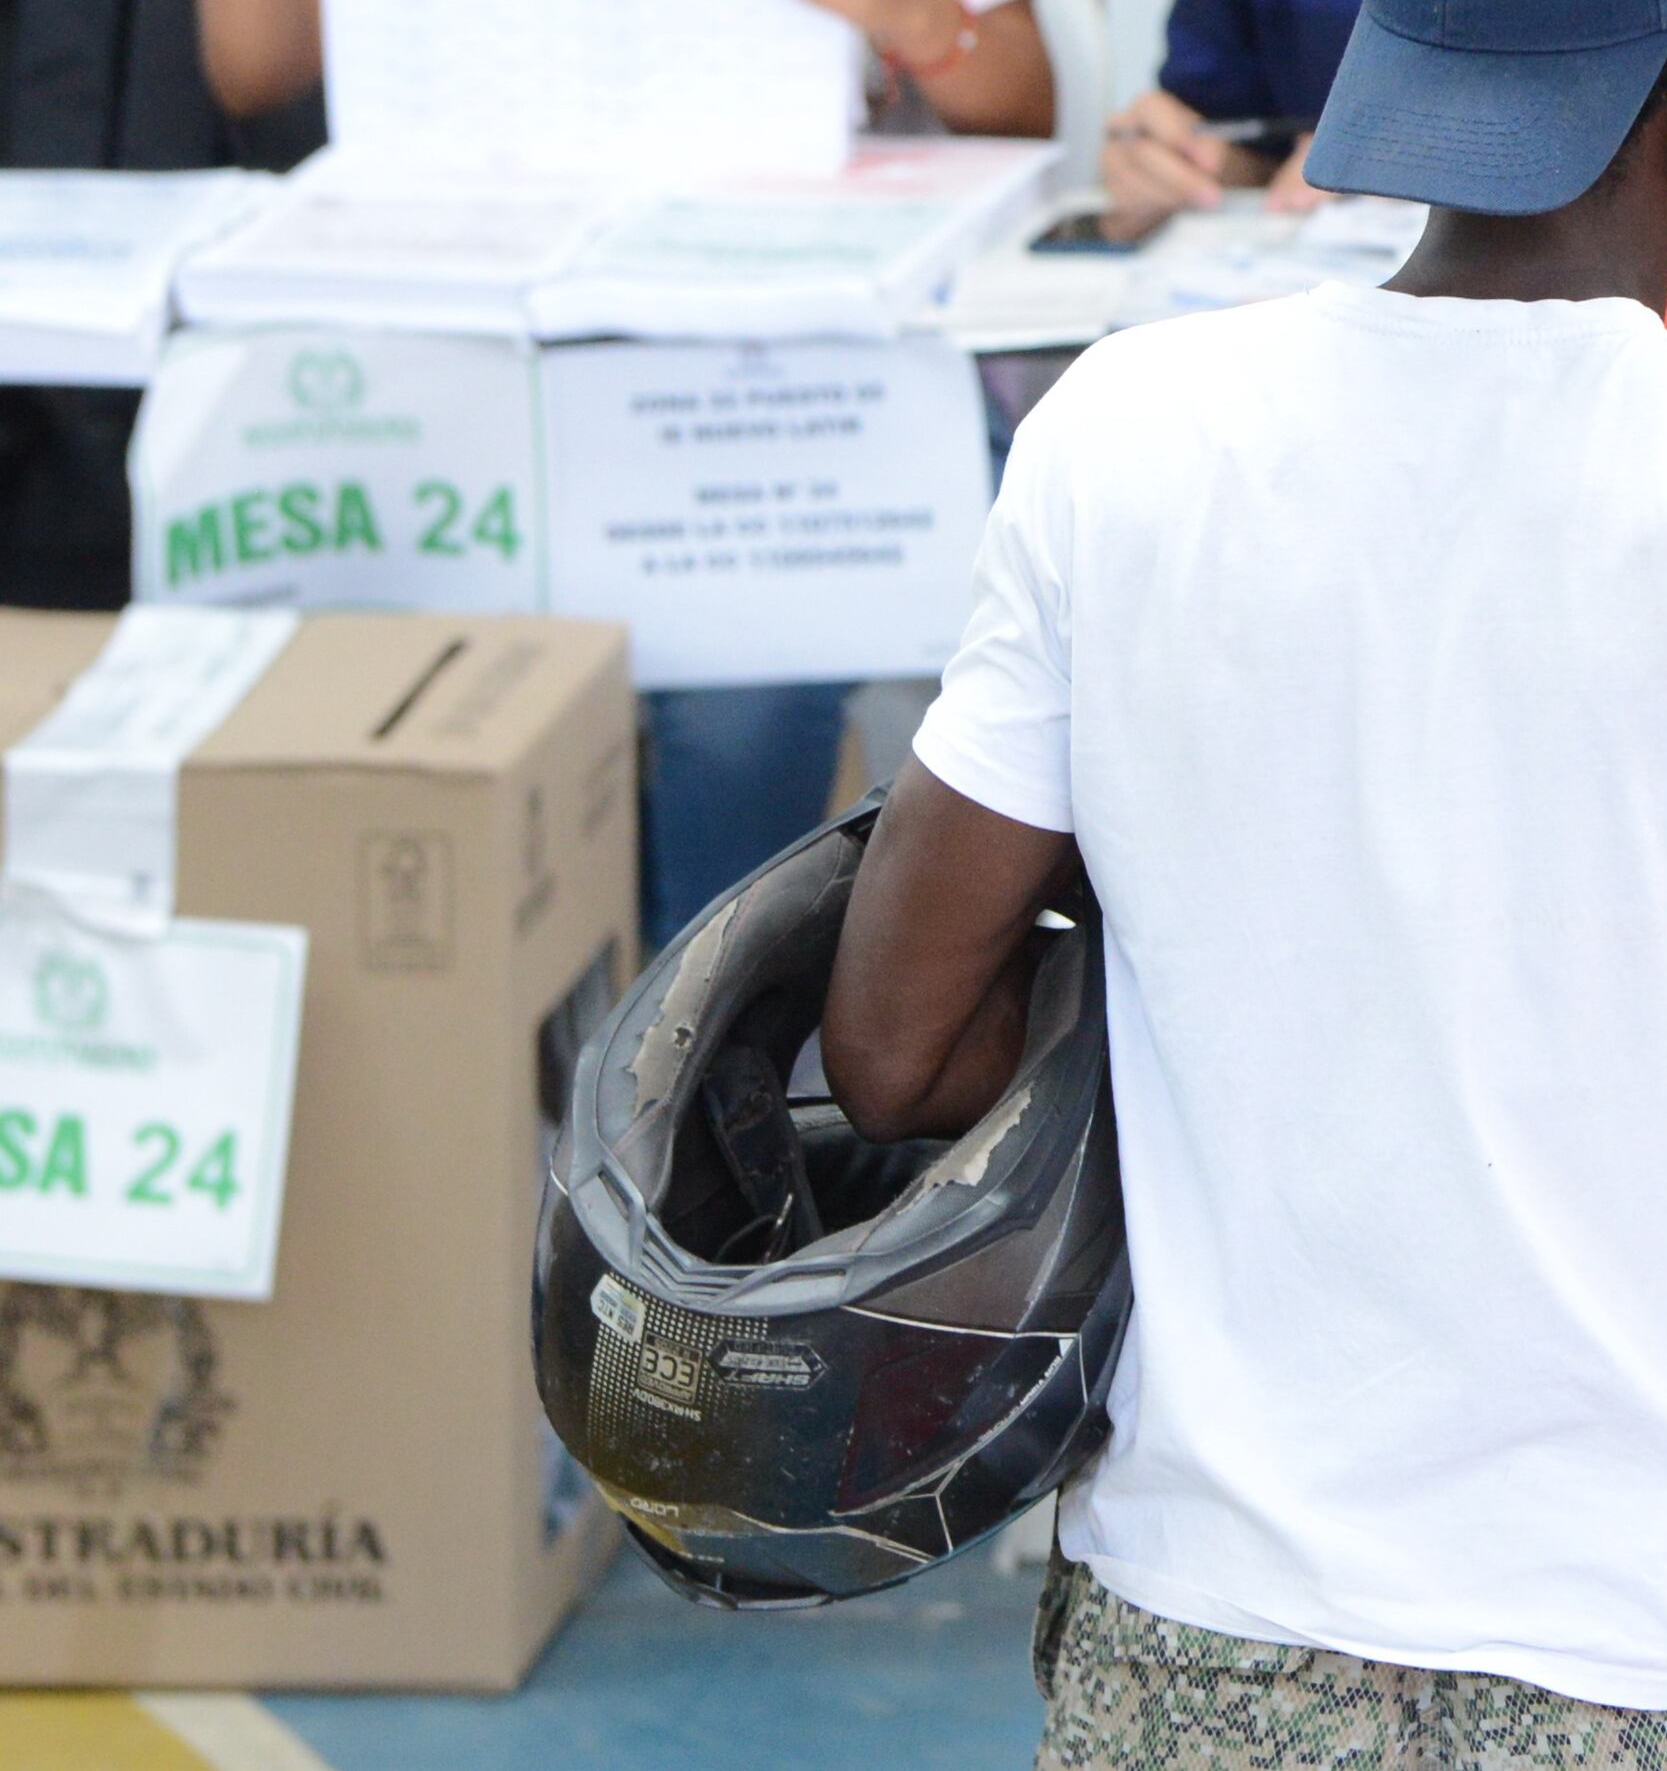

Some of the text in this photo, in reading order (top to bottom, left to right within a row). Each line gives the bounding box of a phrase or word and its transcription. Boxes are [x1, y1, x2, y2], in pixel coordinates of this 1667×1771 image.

[165, 479, 522, 590] MESA 24
[125, 1121, 241, 1210] 24
[642, 1347, 695, 1388] ECE
